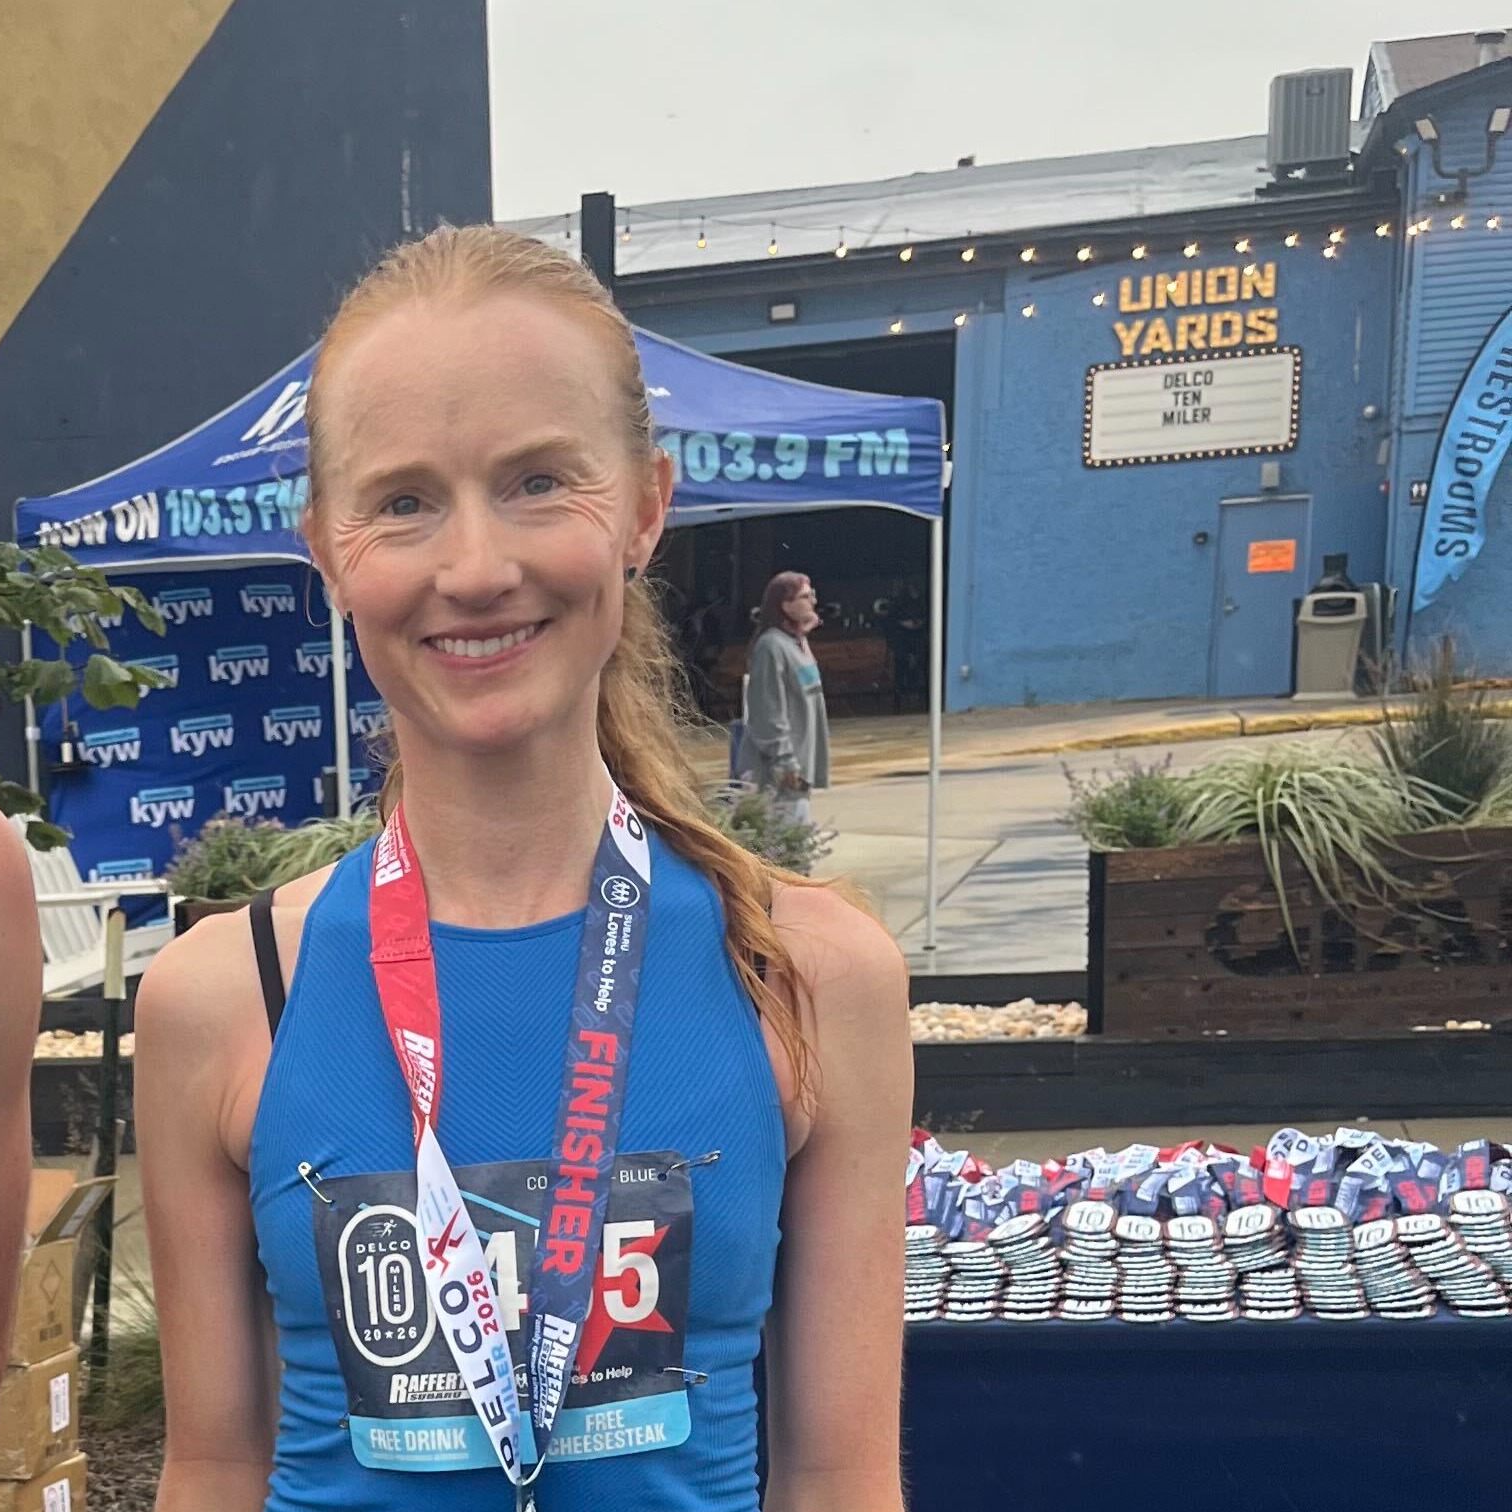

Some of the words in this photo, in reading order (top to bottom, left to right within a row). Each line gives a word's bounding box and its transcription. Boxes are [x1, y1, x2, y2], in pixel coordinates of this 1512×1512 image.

[1118, 261, 1277, 313] UNION
[1113, 308, 1279, 356] YARDS
[1163, 370, 1214, 389] DELCO
[1172, 390, 1202, 407] TEN
[1162, 407, 1211, 427] MILER
[655, 430, 810, 484] 103.9
[824, 428, 909, 478] FM
[111, 492, 160, 543] ON
[254, 475, 310, 532] FM
[240, 588, 296, 618] kyw
[208, 653, 270, 686] kyw
[170, 725, 235, 757] kyw
[262, 714, 323, 746] kyw
[78, 737, 141, 769] kyw
[129, 796, 195, 828] kyw
[224, 785, 287, 816] kyw
[604, 912, 623, 956] Loves
[620, 914, 633, 952] SUBARU
[601, 958, 617, 975] to
[594, 977, 615, 1013] Help
[541, 1029, 619, 1275] FINISHER
[619, 1168, 657, 1184] BLUE
[1076, 1209, 1105, 1225] 10
[1236, 1211, 1264, 1231] 10
[355, 1240, 412, 1254] DELCO
[357, 1253, 415, 1326] 10
[389, 1265, 402, 1312] MILER
[485, 1219, 660, 1332] 45
[466, 1270, 500, 1336] 2026
[389, 1373, 466, 1404] RAFFERT
[439, 1280, 515, 1471] DELCO
[543, 1313, 577, 1432] RAFFERTY
[591, 1371, 604, 1383] to
[605, 1365, 633, 1380] Help
[585, 1409, 625, 1433] FREE
[370, 1428, 402, 1451] FREE
[404, 1427, 467, 1451] DRINK
[548, 1422, 666, 1456] CHEESESTEAK
